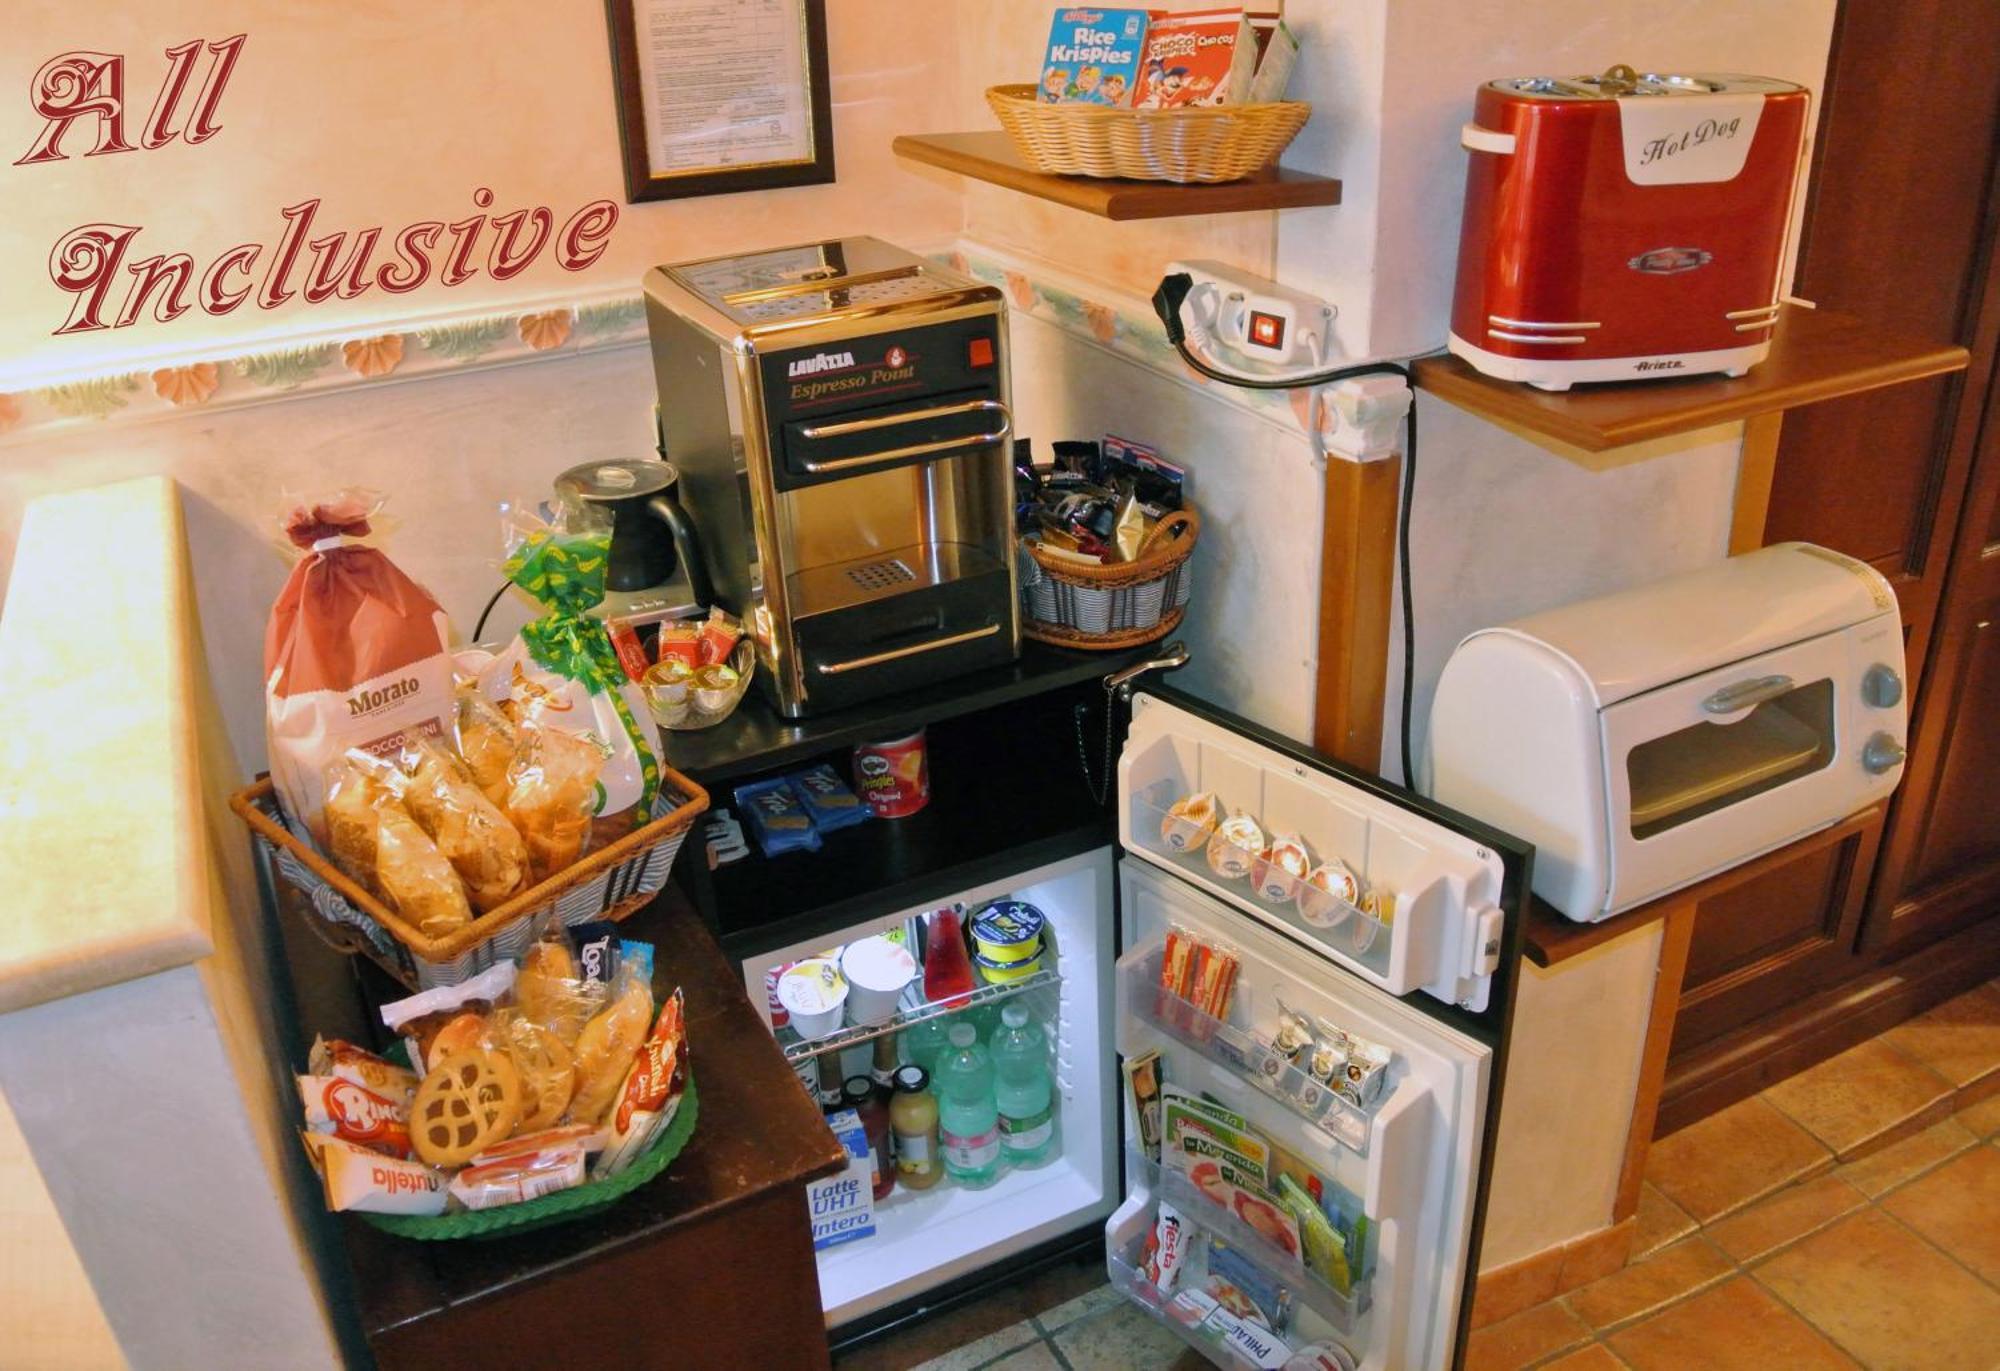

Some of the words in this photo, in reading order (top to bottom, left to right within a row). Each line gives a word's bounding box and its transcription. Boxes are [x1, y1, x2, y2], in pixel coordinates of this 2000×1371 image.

[1074, 27, 1116, 45] Rice
[1640, 130, 1692, 166] Hot
[1695, 116, 1742, 146] Dog
[788, 351, 856, 377] LAVAZZA
[1635, 360, 1686, 372] Ariete
[790, 374, 867, 400] Espresso
[871, 365, 915, 384] Point
[346, 678, 420, 716] Morato
[372, 1167, 439, 1194] nutella
[813, 1179, 859, 1201] Latte
[814, 1190, 861, 1215] UHT
[812, 1213, 869, 1238] Intero
[1163, 1215, 1181, 1269] fiesta
